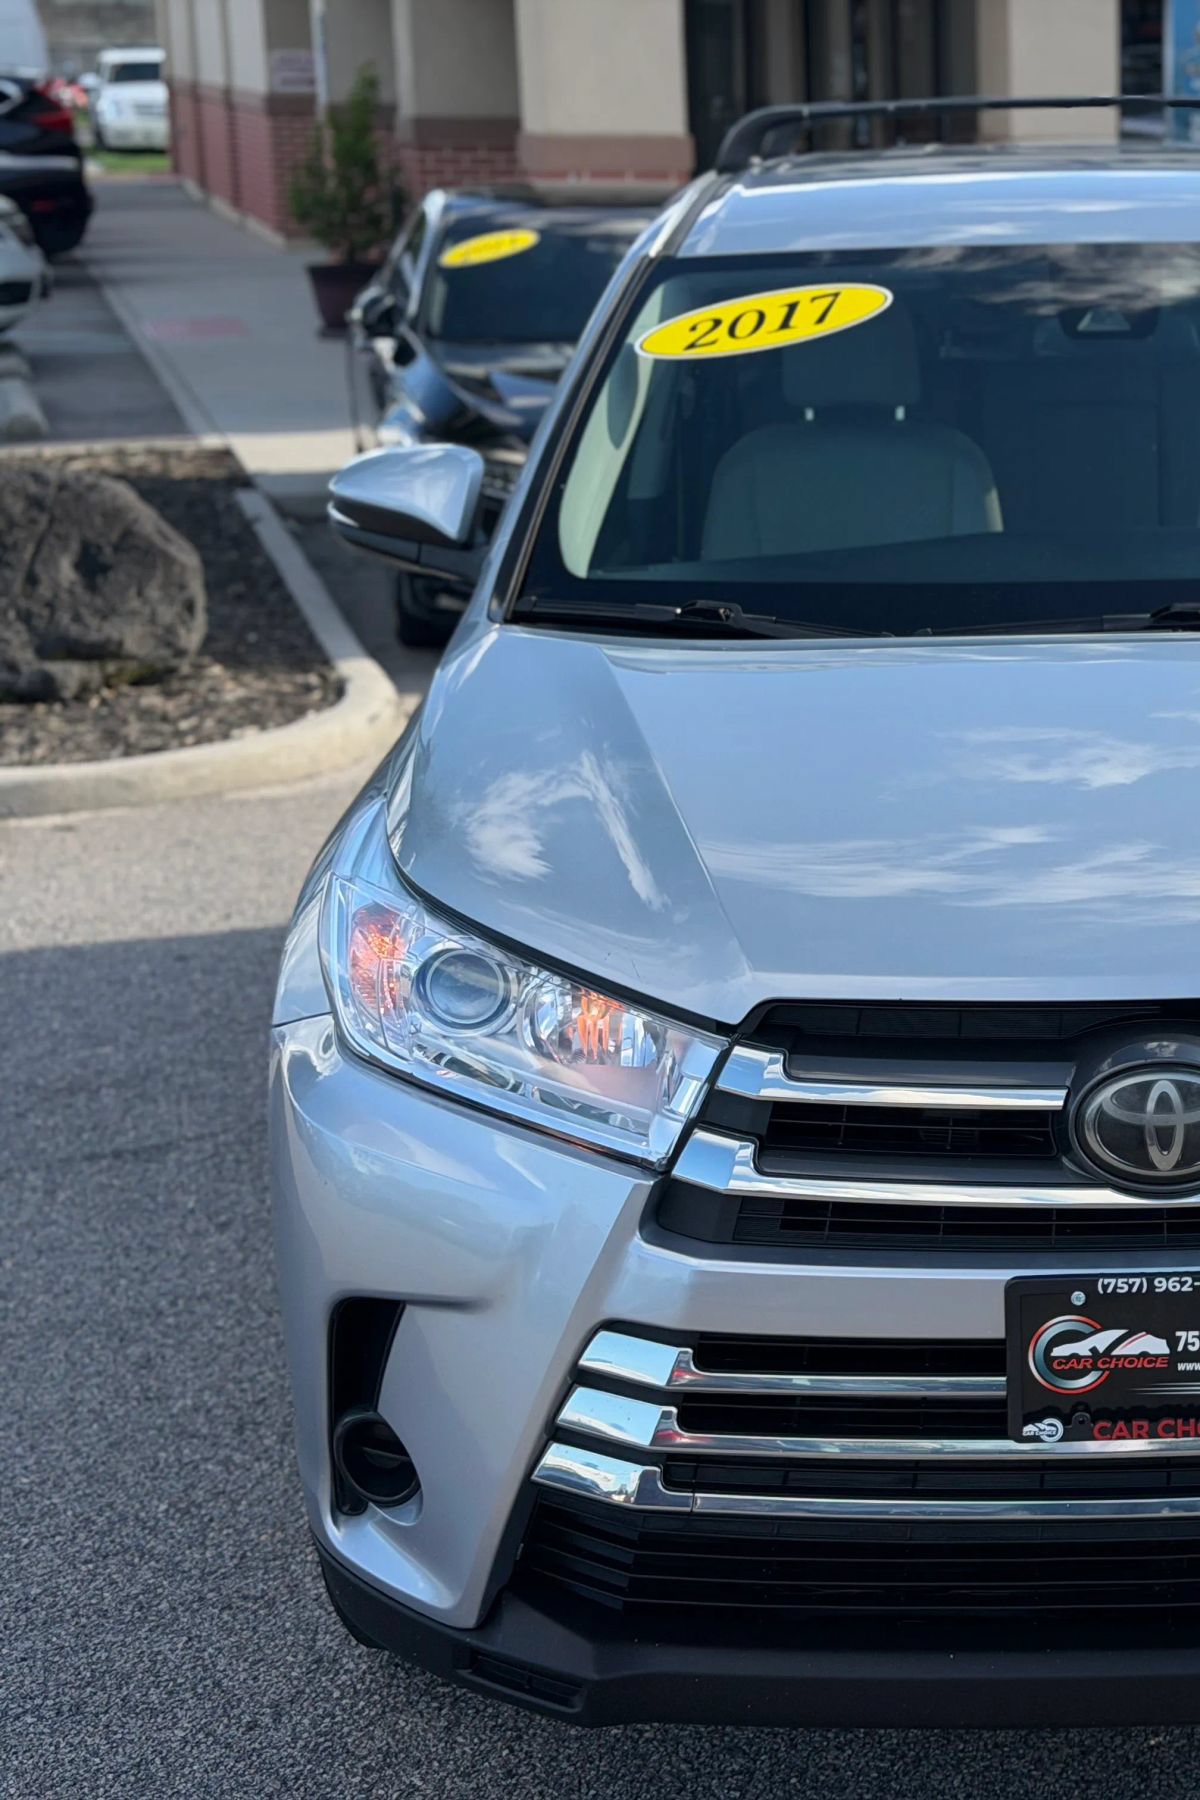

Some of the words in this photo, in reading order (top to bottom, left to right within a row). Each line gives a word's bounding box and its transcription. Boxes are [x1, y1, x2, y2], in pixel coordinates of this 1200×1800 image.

[683, 291, 842, 351] 2017
[1097, 1276, 1148, 1295] (757)
[1052, 1358, 1093, 1370] CAR
[1097, 1356, 1170, 1369] CHOICE
[1092, 1420, 1151, 1441] CAR
